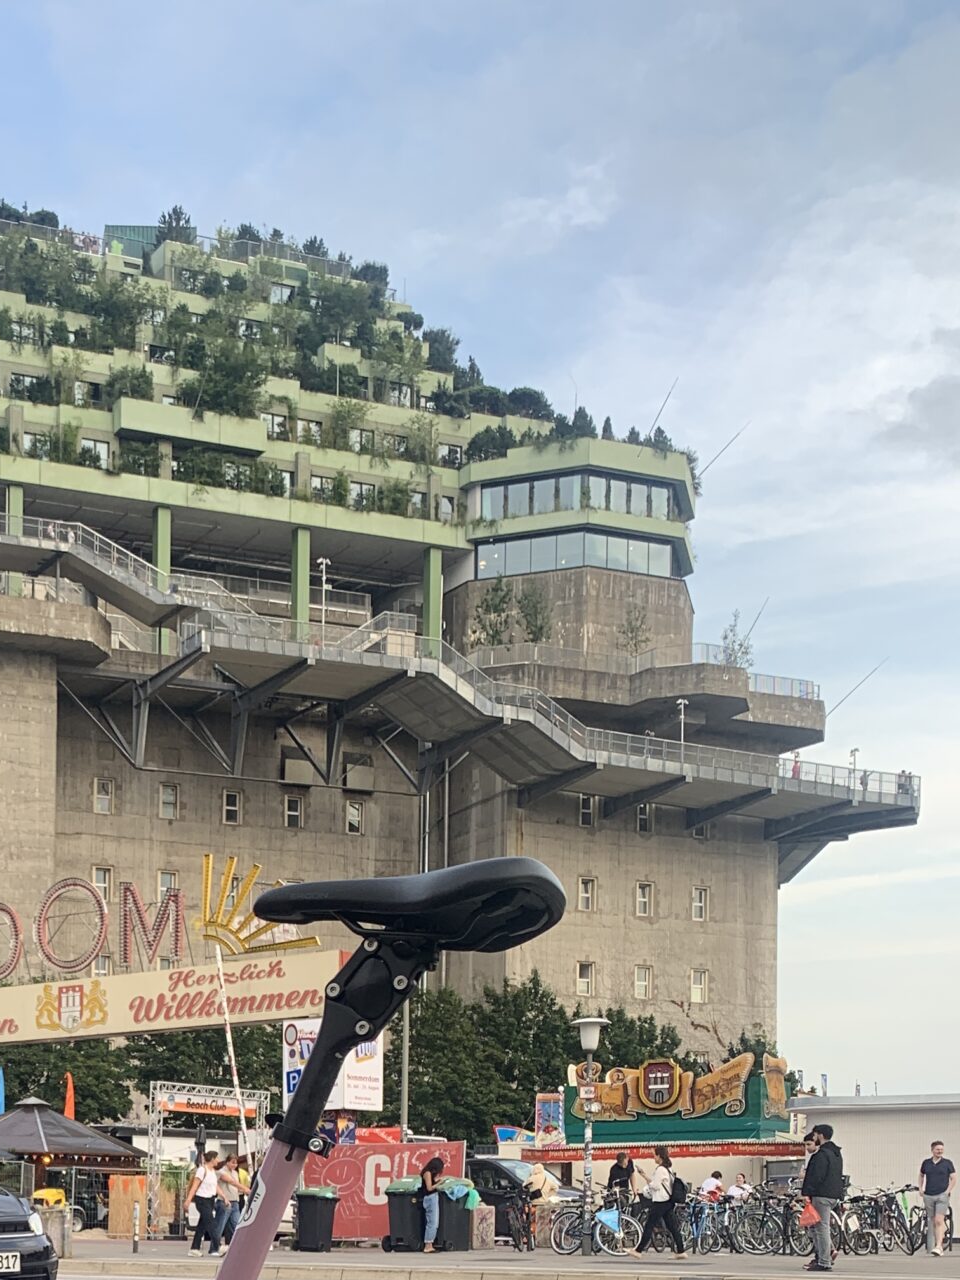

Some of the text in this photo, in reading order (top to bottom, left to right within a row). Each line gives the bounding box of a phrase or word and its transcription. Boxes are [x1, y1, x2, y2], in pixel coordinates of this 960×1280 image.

[168, 960, 286, 992] Herzlich
[128, 988, 323, 1024] Willkommen
[186, 1098, 227, 1111] Beach Club
